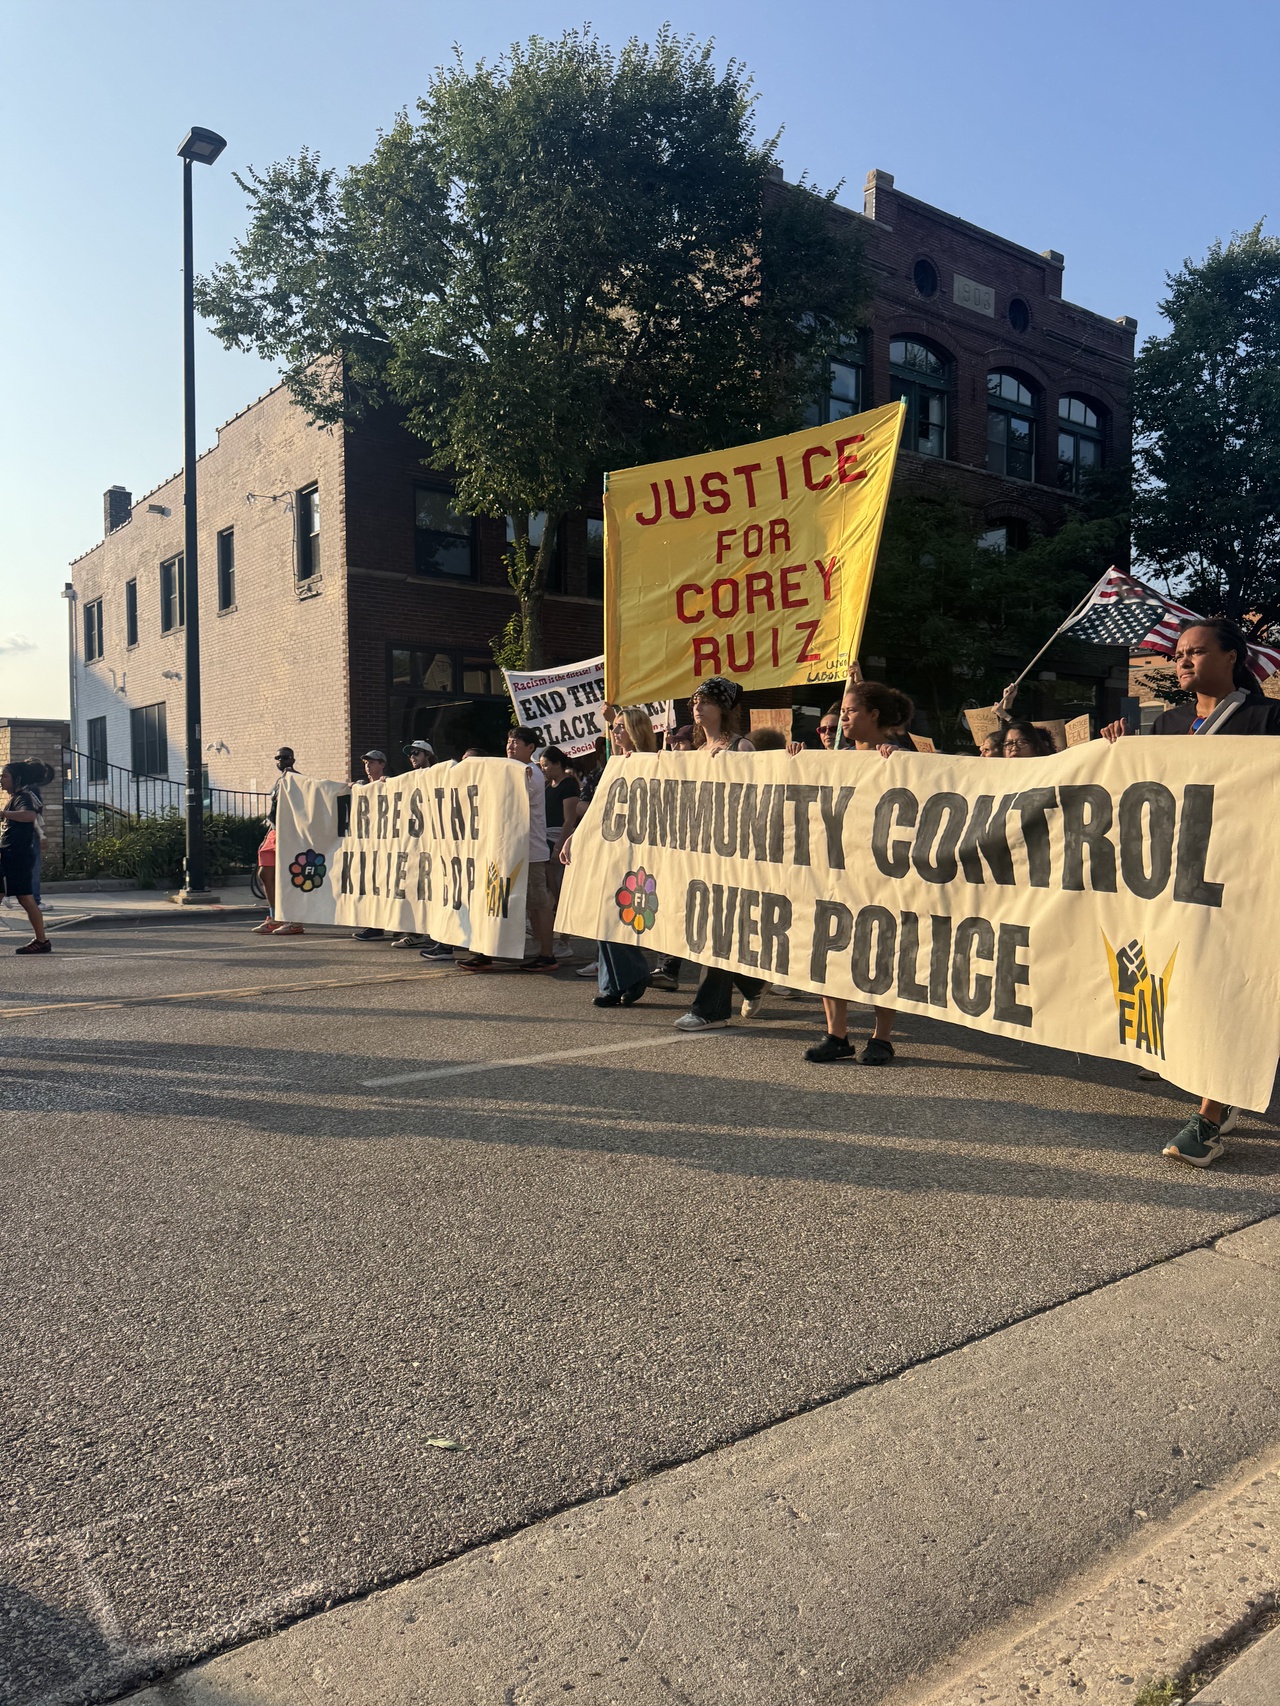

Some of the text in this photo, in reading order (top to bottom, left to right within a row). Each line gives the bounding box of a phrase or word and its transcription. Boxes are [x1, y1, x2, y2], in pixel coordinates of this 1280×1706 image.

[635, 433, 868, 526] JUSTICE
[715, 518, 791, 564] FOR
[675, 556, 838, 624] COREY
[692, 619, 821, 677] RUIZ
[512, 677, 548, 692] Racism
[548, 675, 555, 684] is
[554, 673, 565, 682] the
[565, 666, 592, 679] disease!
[518, 677, 605, 722] END THE
[532, 711, 602, 748] BLACK
[337, 785, 480, 840] ARRES THE
[601, 777, 1225, 907] COMMUNITY CONTROL
[305, 866, 315, 875] FI
[440, 855, 476, 911] OP
[485, 876, 511, 918] AN
[634, 892, 646, 908] FI
[685, 879, 1033, 1027] OVER POLICE
[1118, 974, 1166, 1061] FAN
